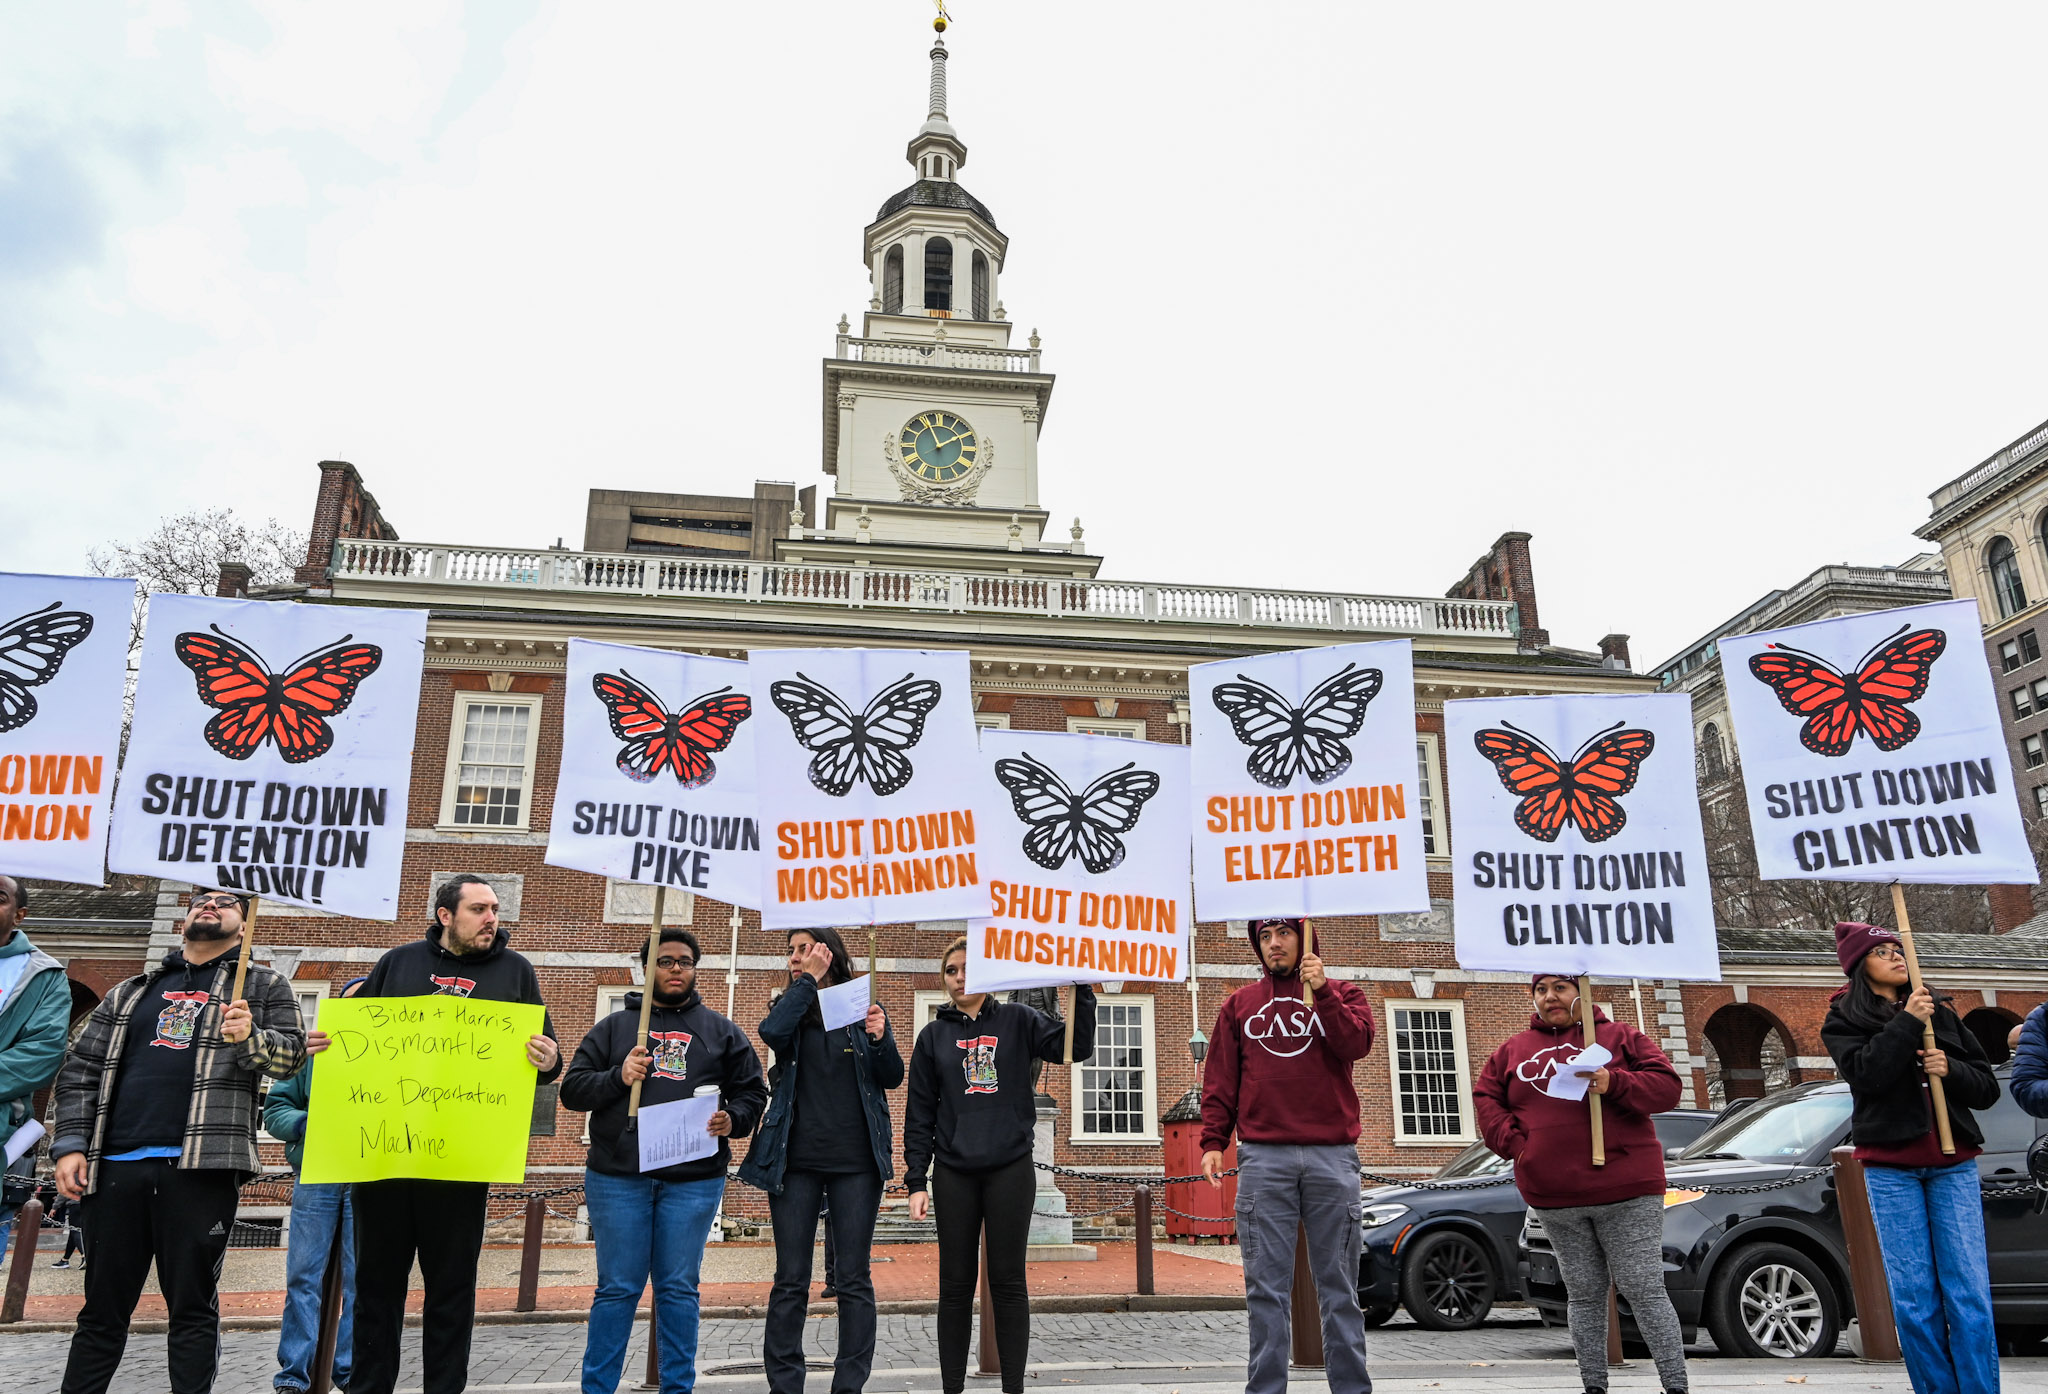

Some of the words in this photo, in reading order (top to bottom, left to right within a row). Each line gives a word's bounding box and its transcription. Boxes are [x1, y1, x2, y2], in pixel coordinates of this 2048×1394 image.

[142, 773, 256, 820] SHUT
[261, 782, 388, 826] DOWN
[1207, 795, 1295, 834] SHUT
[1303, 784, 1406, 828] DOWN
[1764, 771, 1863, 819] SHUT
[1872, 757, 1997, 805] DOWN
[0, 803, 92, 841] NON
[158, 823, 370, 868] DETENTION
[573, 801, 663, 838] SHUT
[668, 809, 760, 851] DOWN
[777, 819, 865, 860] SHUT
[873, 810, 976, 856] DOWN
[1793, 813, 1981, 871] CLINTON
[631, 841, 711, 889] PIKE
[777, 852, 979, 903] MOSHANNON
[1225, 835, 1398, 883] ELIZABETH
[1473, 851, 1564, 891] SHUT
[1574, 851, 1685, 892] DOWN
[216, 865, 325, 905] NOW!
[990, 880, 1073, 924] SHUT
[1078, 891, 1176, 934] DOWN
[1504, 902, 1674, 946] CLINTON
[984, 927, 1177, 980] MOSHANNON
[359, 1004, 425, 1028] Biden
[456, 1006, 515, 1032] Harris,
[1244, 1011, 1326, 1040] CASA
[330, 1030, 493, 1062] Dismantle
[348, 1083, 388, 1104] the
[397, 1076, 507, 1112] Deportation
[361, 1119, 448, 1159] Machine
